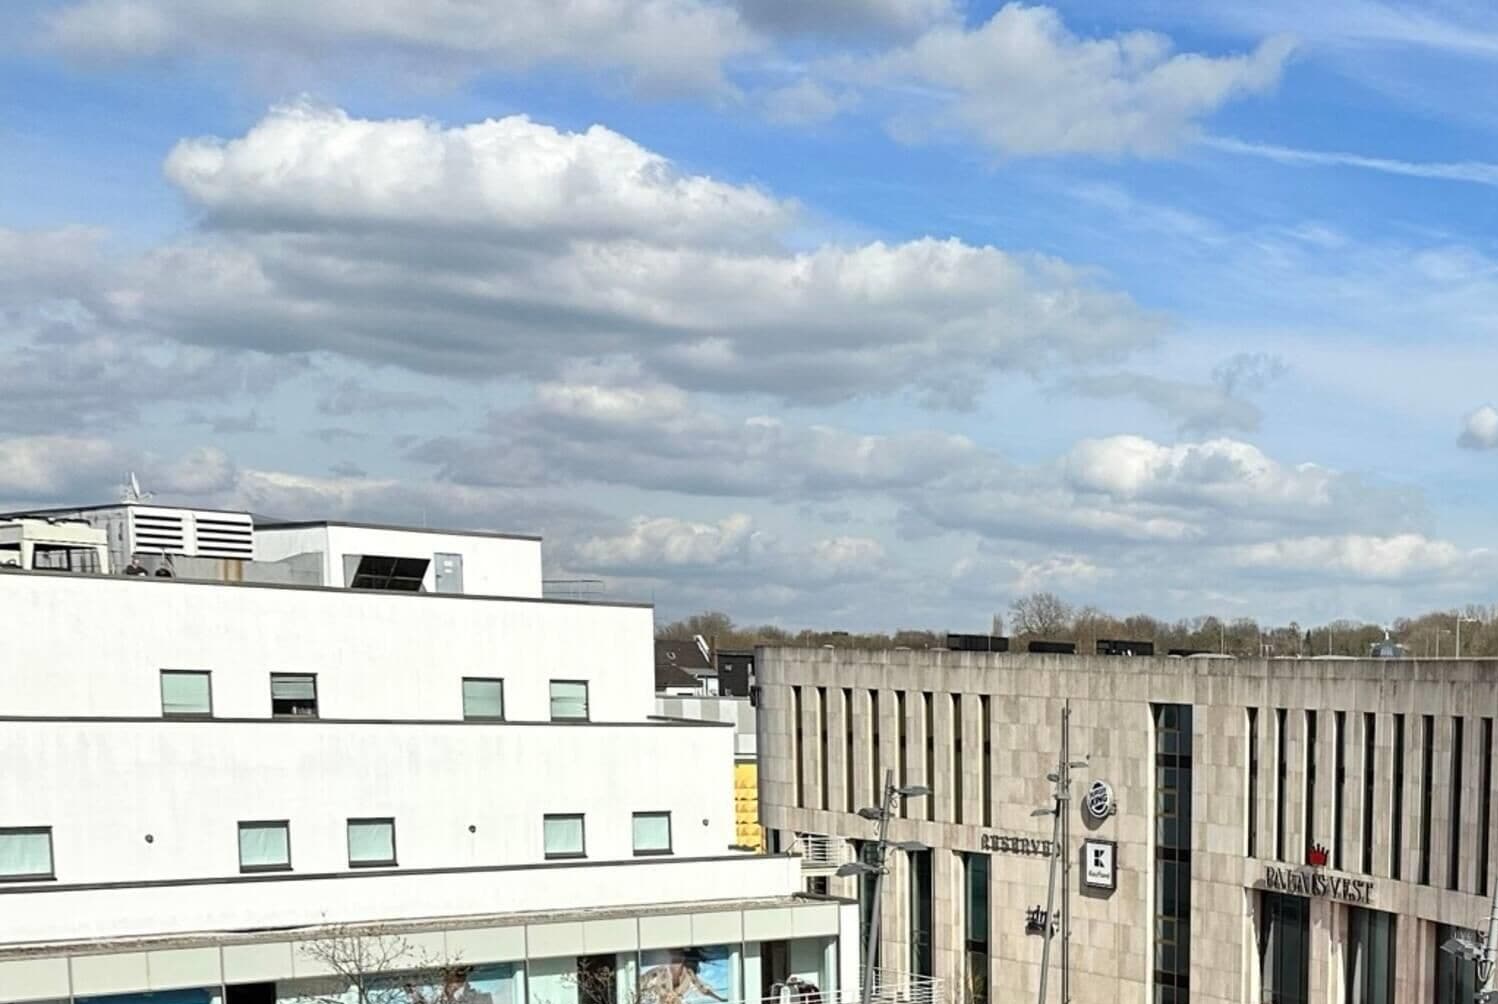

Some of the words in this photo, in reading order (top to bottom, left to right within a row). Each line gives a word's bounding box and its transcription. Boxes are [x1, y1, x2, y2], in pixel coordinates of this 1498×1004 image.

[1094, 849, 1105, 868] K
[1265, 866, 1328, 896] PALAIS
[1329, 876, 1374, 904] VEST
